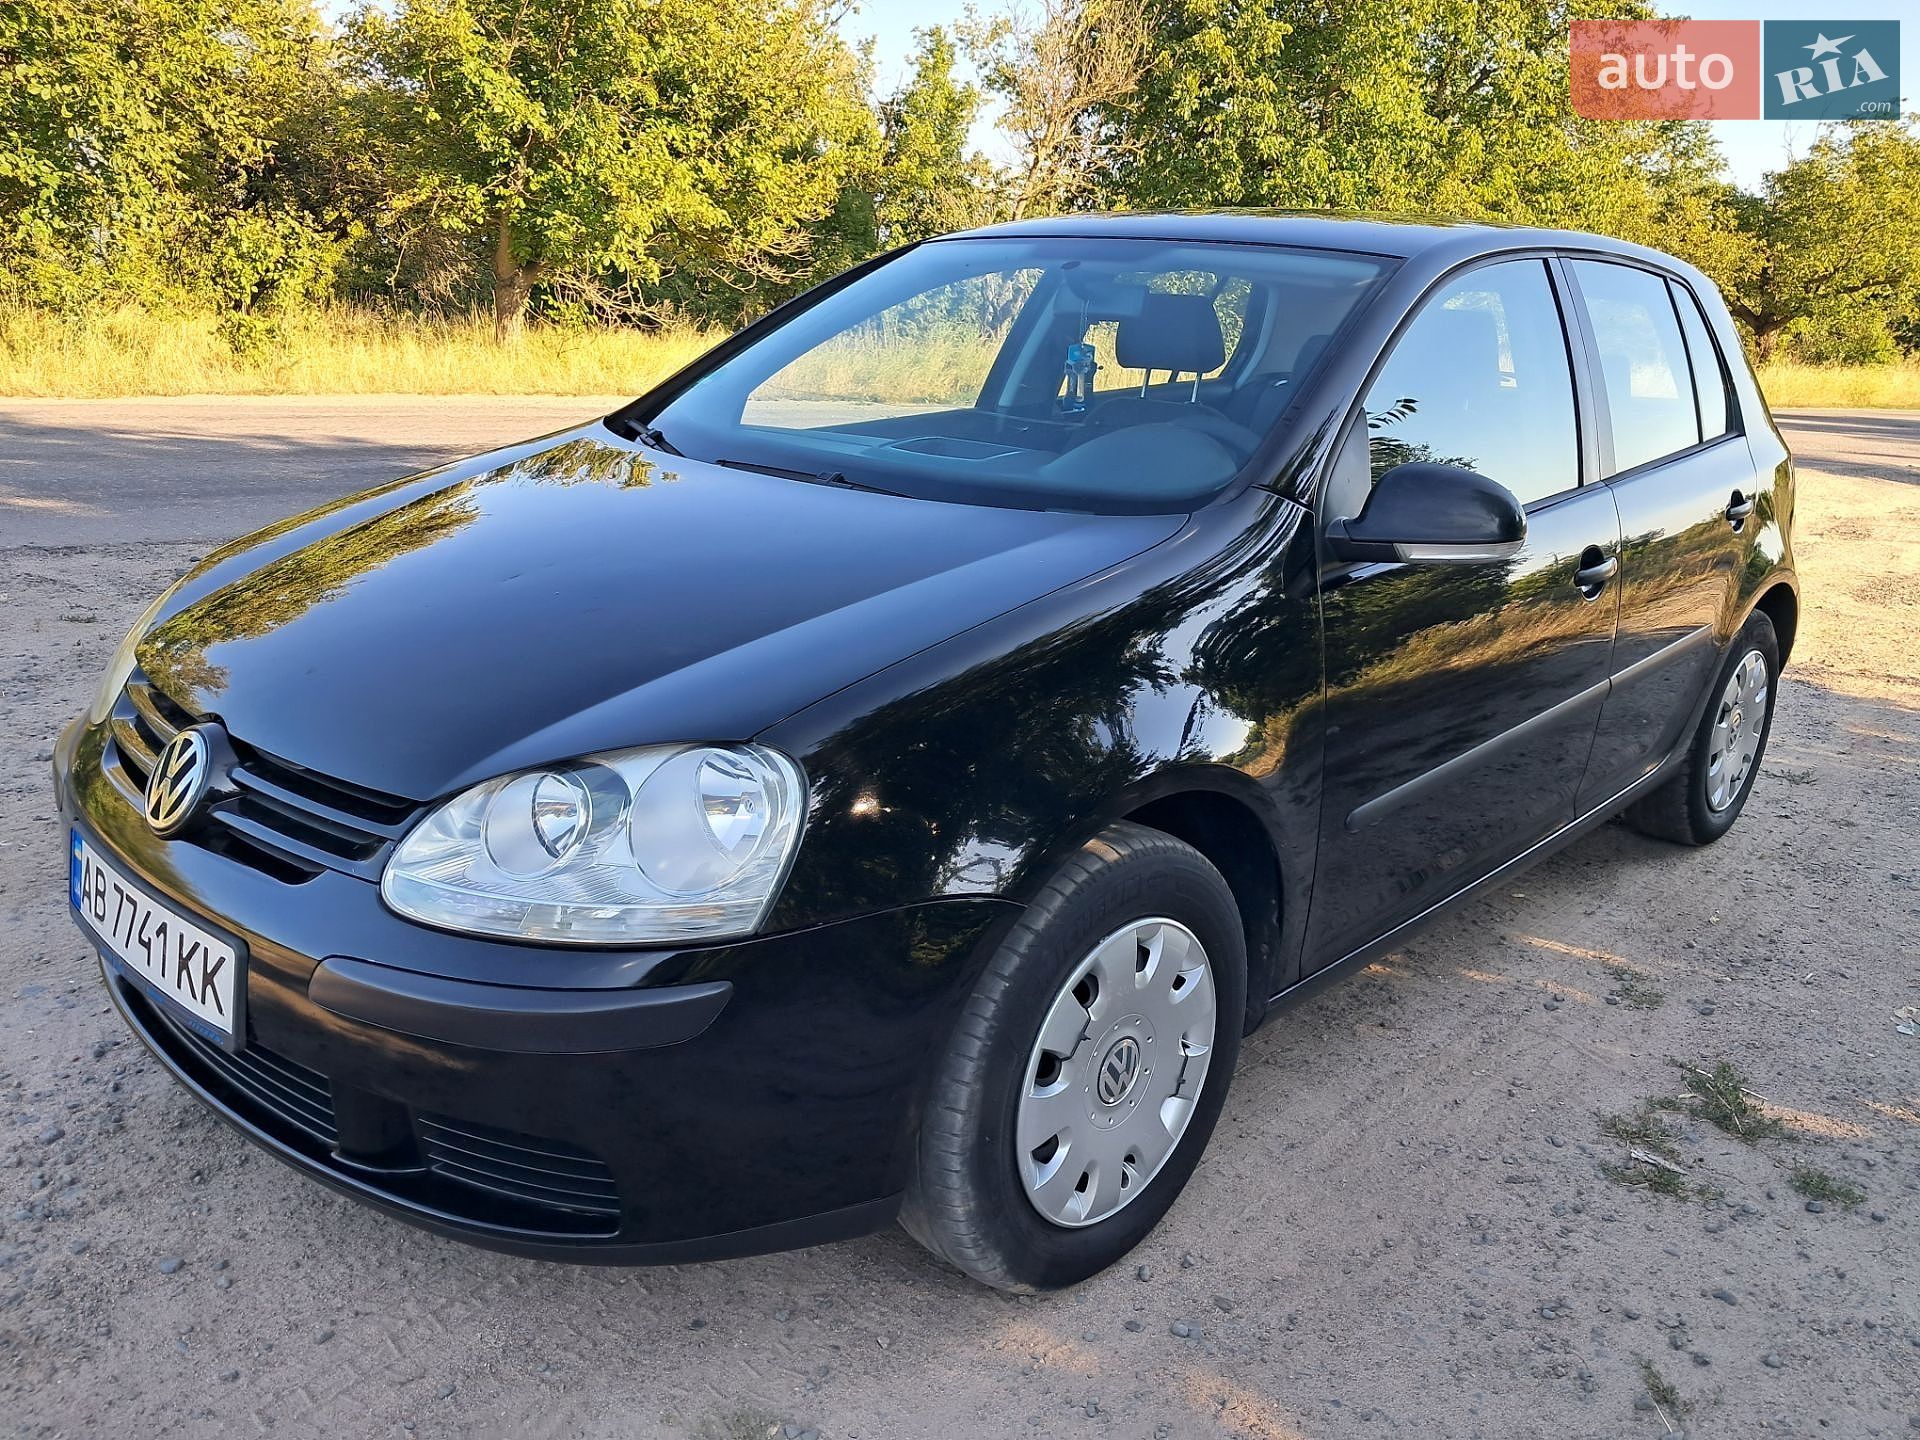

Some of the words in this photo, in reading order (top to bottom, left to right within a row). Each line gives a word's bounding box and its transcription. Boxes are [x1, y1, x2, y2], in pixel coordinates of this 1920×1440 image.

[81, 855, 107, 922] AB
[112, 881, 168, 979] 7741
[176, 931, 226, 1017] KK
